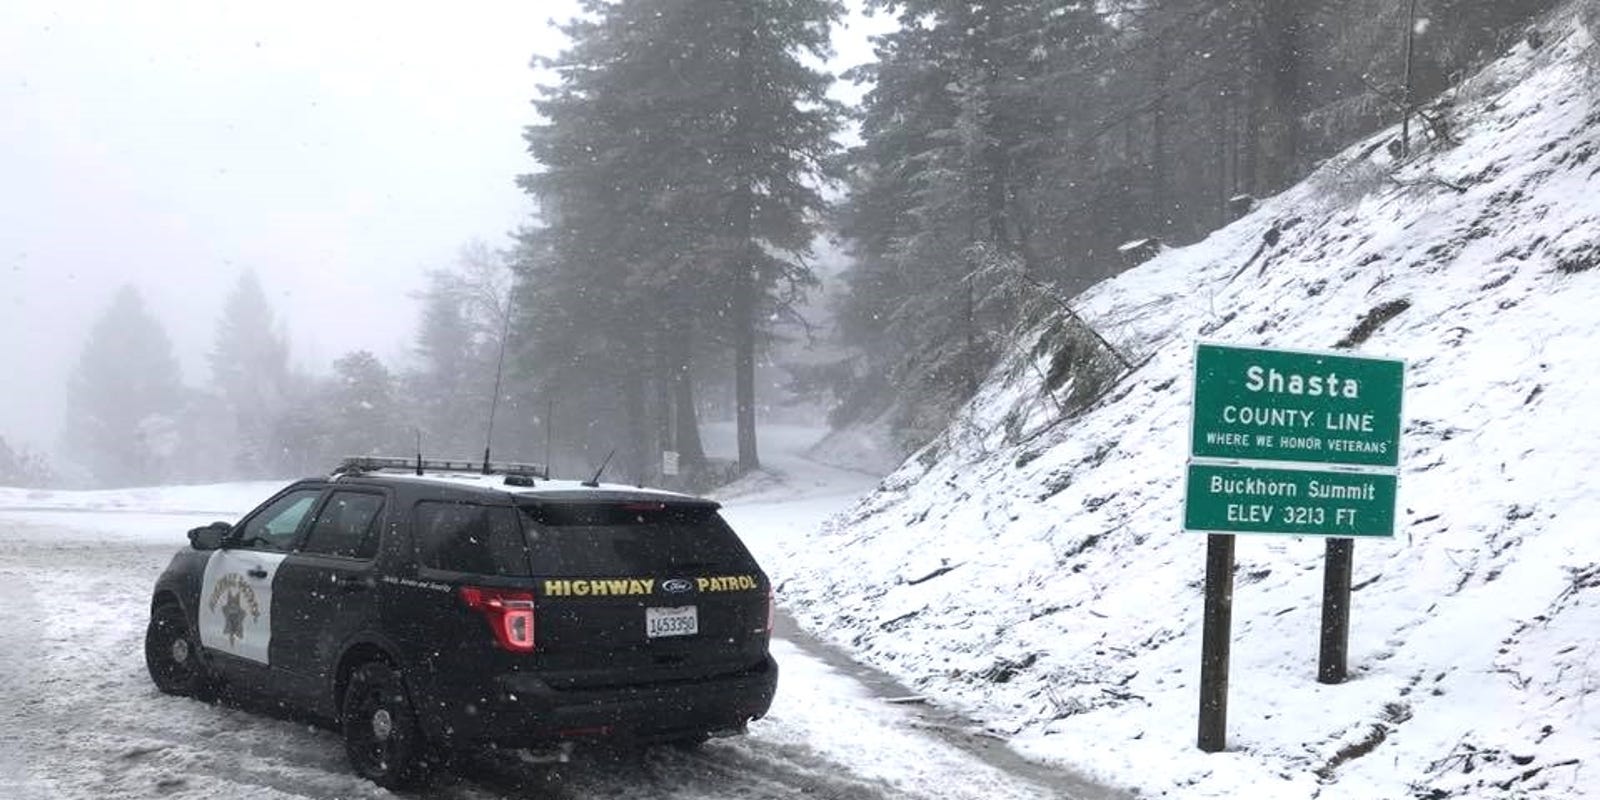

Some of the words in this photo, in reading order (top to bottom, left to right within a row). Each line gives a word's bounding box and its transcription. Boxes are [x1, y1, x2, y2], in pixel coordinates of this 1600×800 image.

[1245, 365, 1359, 398] Shasta
[1223, 405, 1314, 428] COUNTY
[1326, 413, 1374, 432] LINE
[1206, 432, 1250, 446] WHERE
[1256, 435, 1274, 447] WE
[1280, 436, 1322, 450] HONOR
[1328, 438, 1388, 453] VETERANS
[1210, 475, 1297, 497] Buckhorn
[1308, 480, 1376, 500] Summit
[1227, 503, 1273, 523] ELEV
[1283, 506, 1325, 525] 3213
[1335, 508, 1357, 526] FT
[544, 579, 654, 597] HIGHWAY
[696, 575, 758, 592] PATROL
